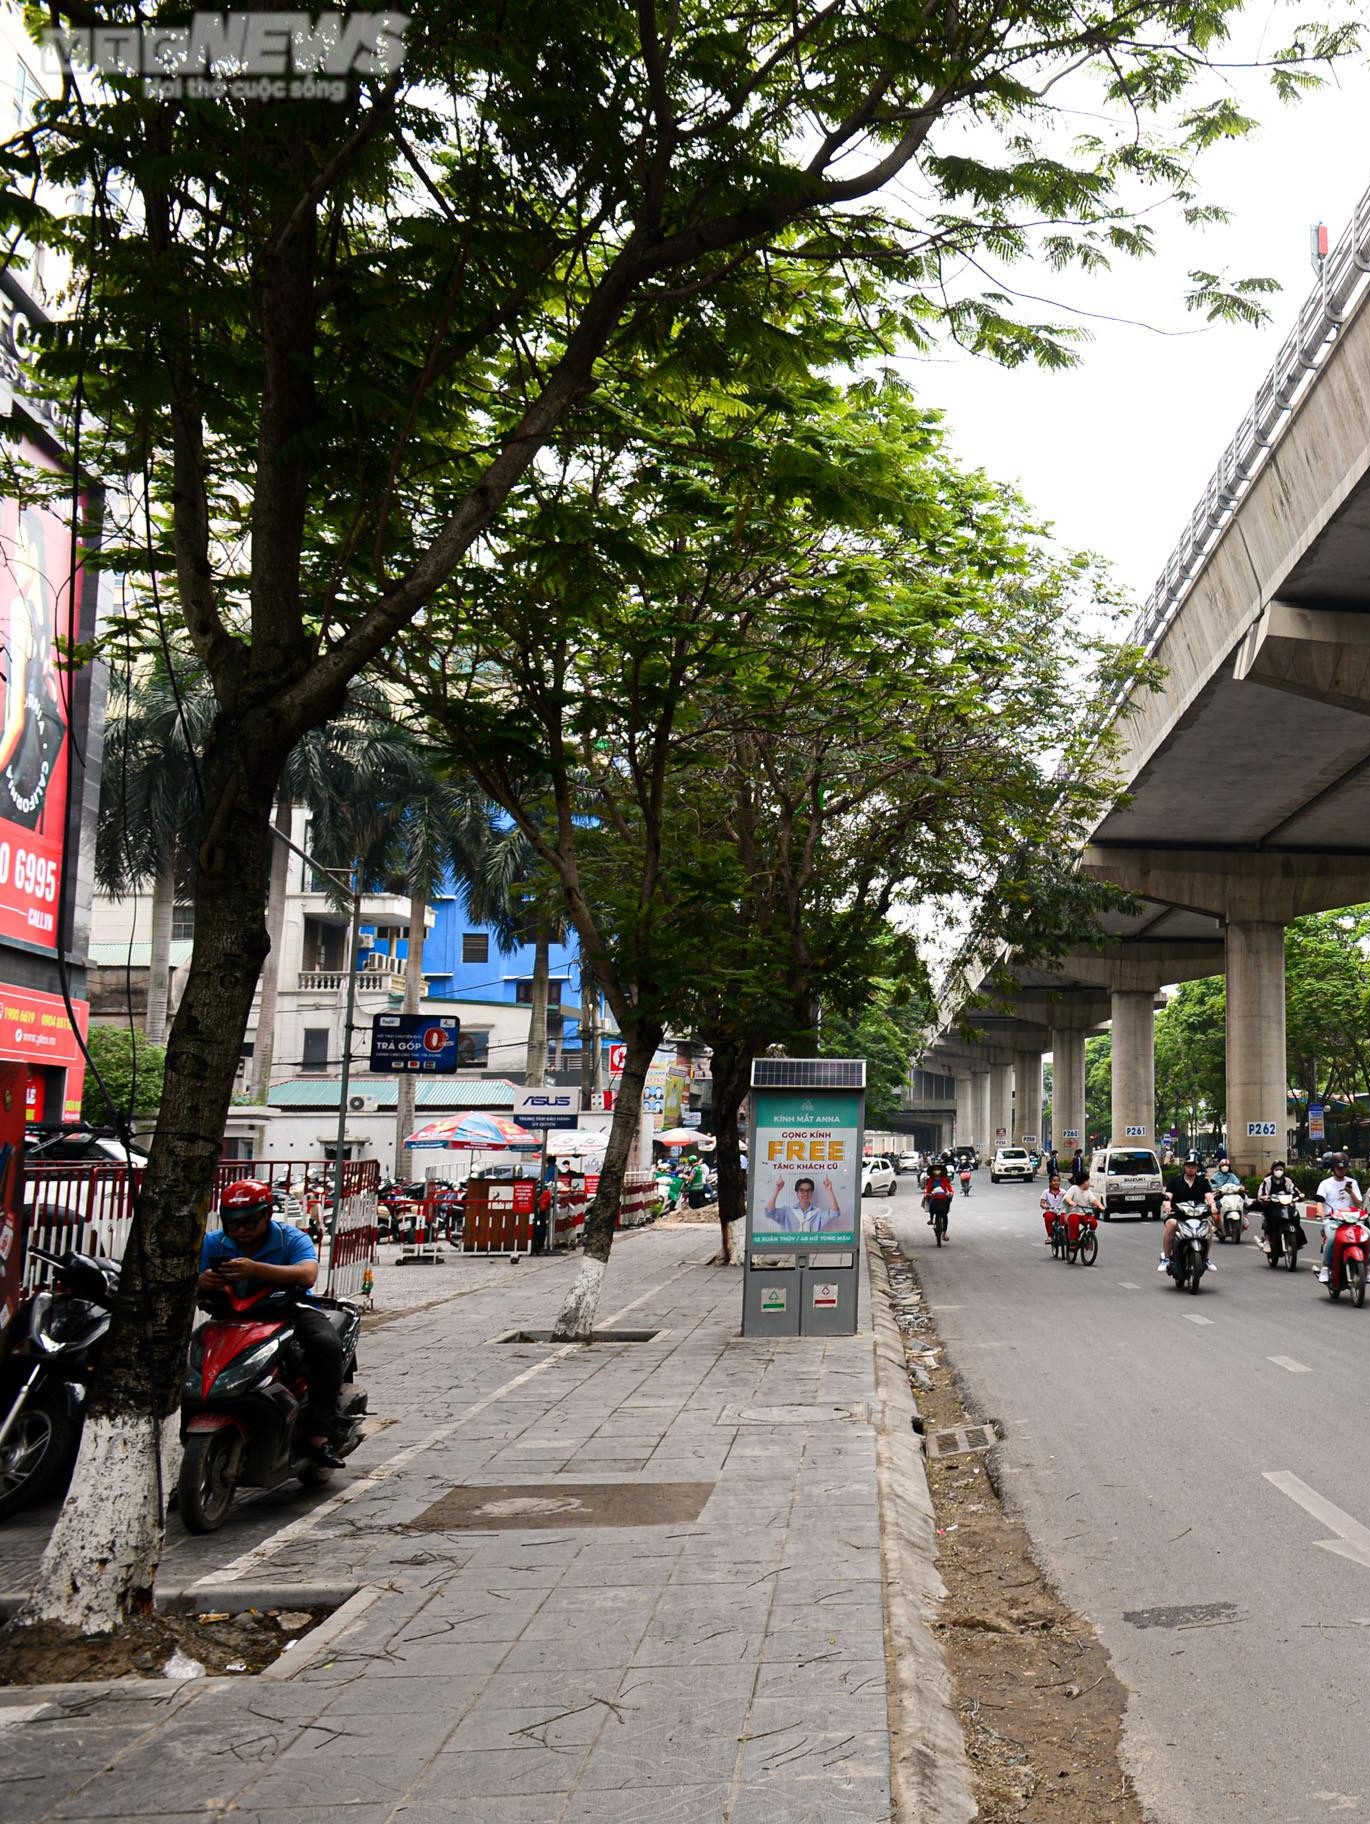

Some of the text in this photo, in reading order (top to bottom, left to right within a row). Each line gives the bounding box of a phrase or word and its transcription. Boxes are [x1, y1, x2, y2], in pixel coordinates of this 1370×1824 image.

[14, 848, 57, 903] 6995
[376, 1039, 422, 1051] TRẢ GÓP
[522, 1095, 571, 1106] ASUS
[773, 1113, 840, 1123] KÍNH MẮT ANNA
[1126, 1127, 1145, 1135] P261
[1248, 1123, 1276, 1135] P262
[781, 1130, 832, 1140] GỌNG KÍNH
[768, 1140, 844, 1161] FREE
[796, 1161, 825, 1170] KHÁCH
